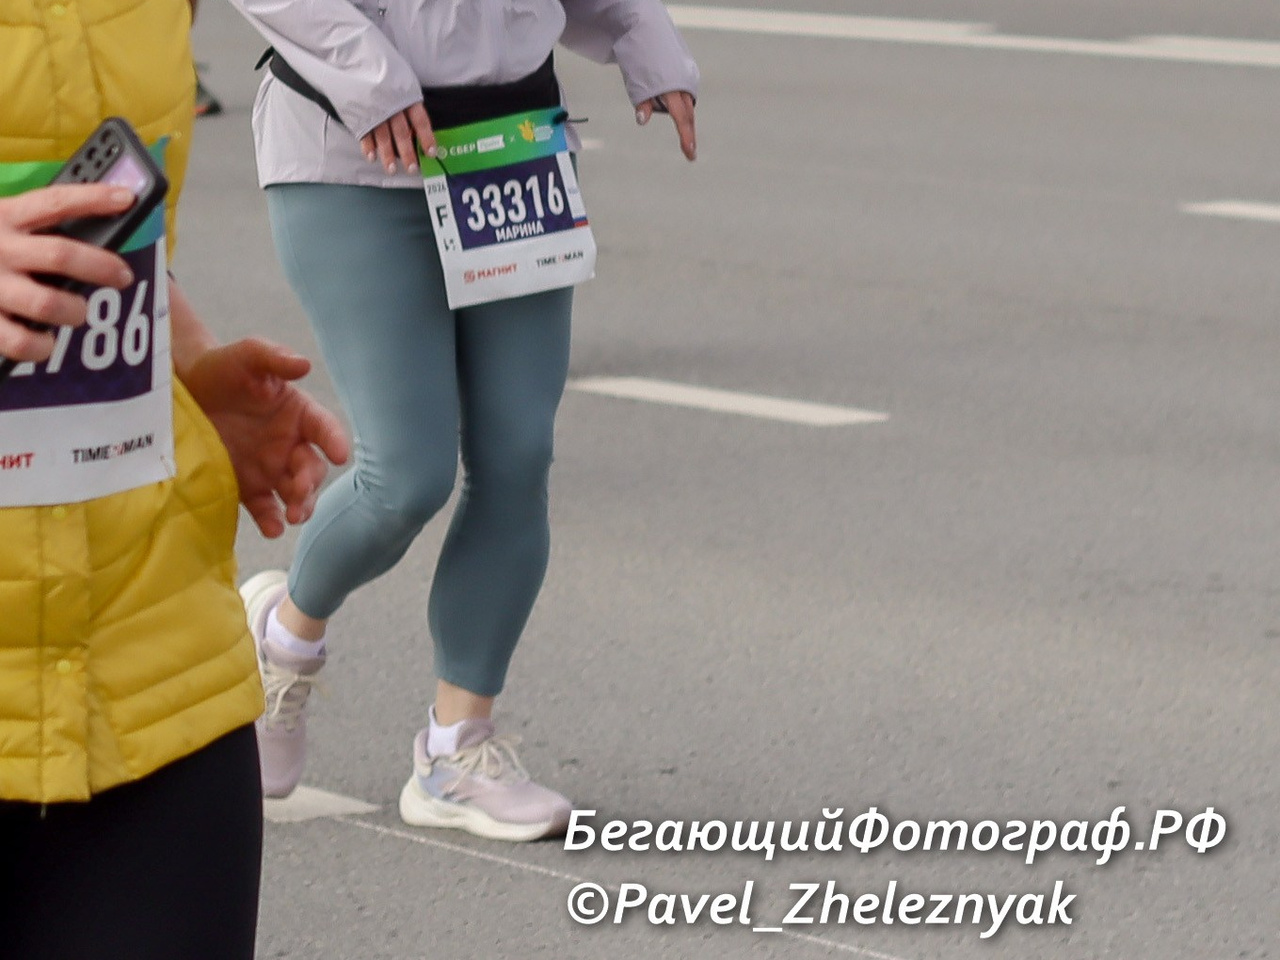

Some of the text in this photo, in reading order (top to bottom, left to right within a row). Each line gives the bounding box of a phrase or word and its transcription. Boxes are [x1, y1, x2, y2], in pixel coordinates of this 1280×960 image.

[461, 171, 565, 232] 33316
[435, 204, 448, 228] F
[495, 219, 545, 243] МАРИНА
[477, 263, 518, 280] МАГНИТ
